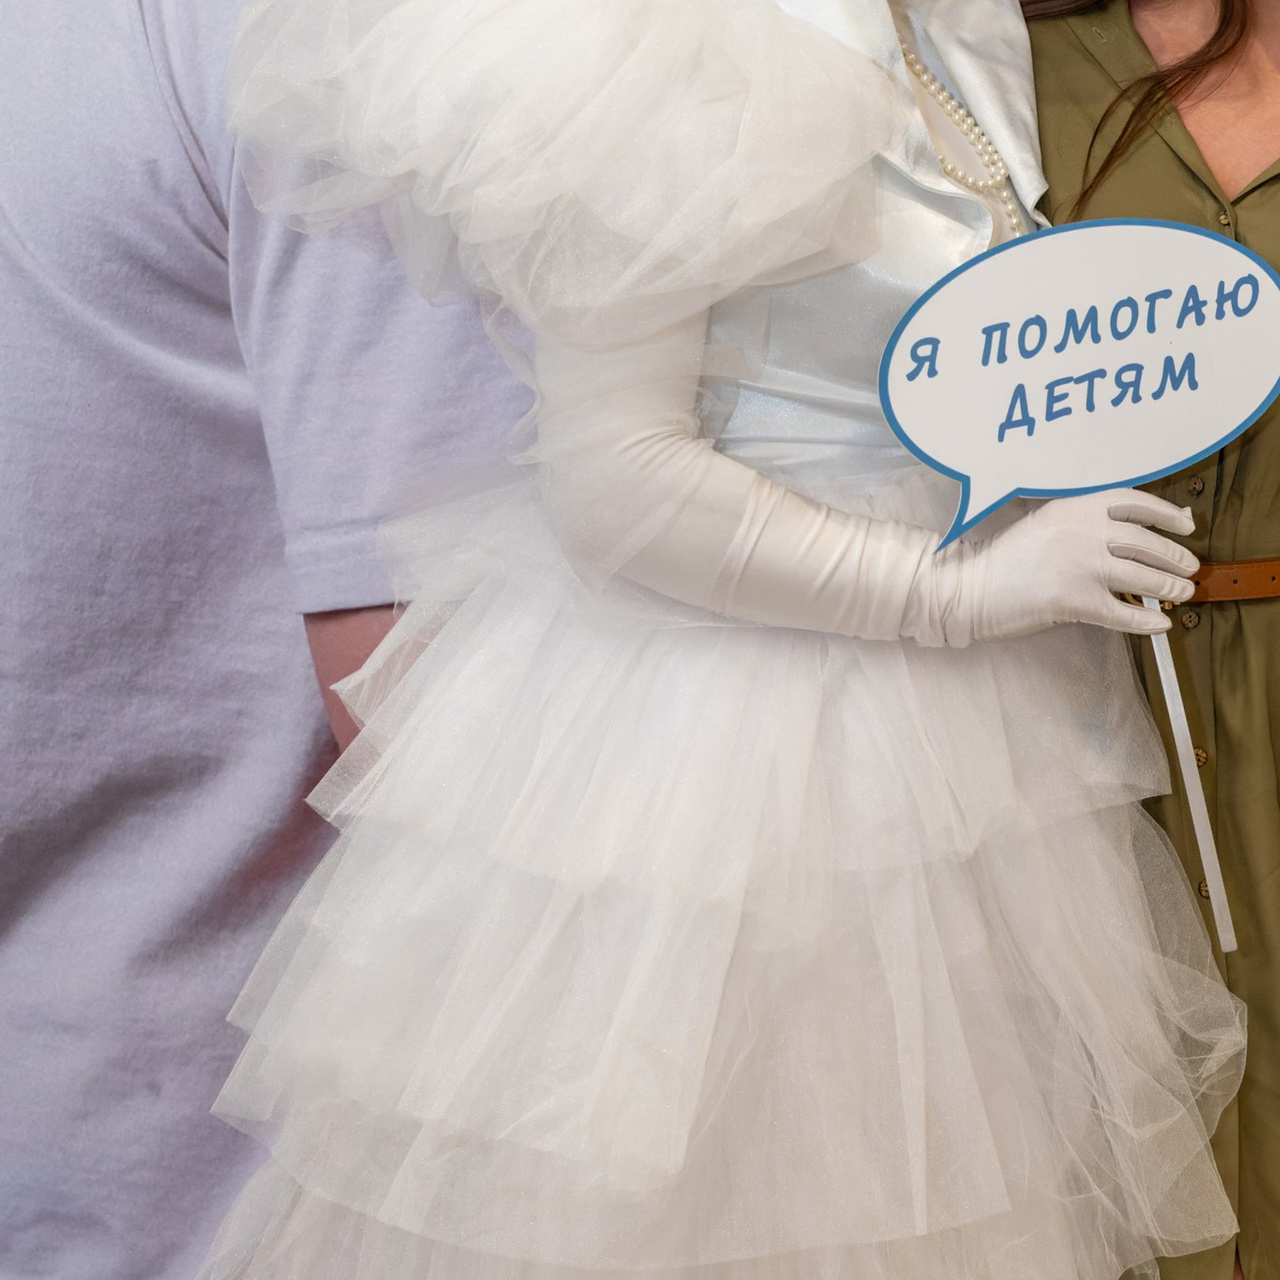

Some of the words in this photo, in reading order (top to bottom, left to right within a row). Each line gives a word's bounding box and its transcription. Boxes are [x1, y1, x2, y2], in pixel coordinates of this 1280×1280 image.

[906, 337, 941, 381] Я
[981, 273, 1260, 367] ПОМОГАЮ
[997, 352, 1199, 443] ДЕТЯМ
